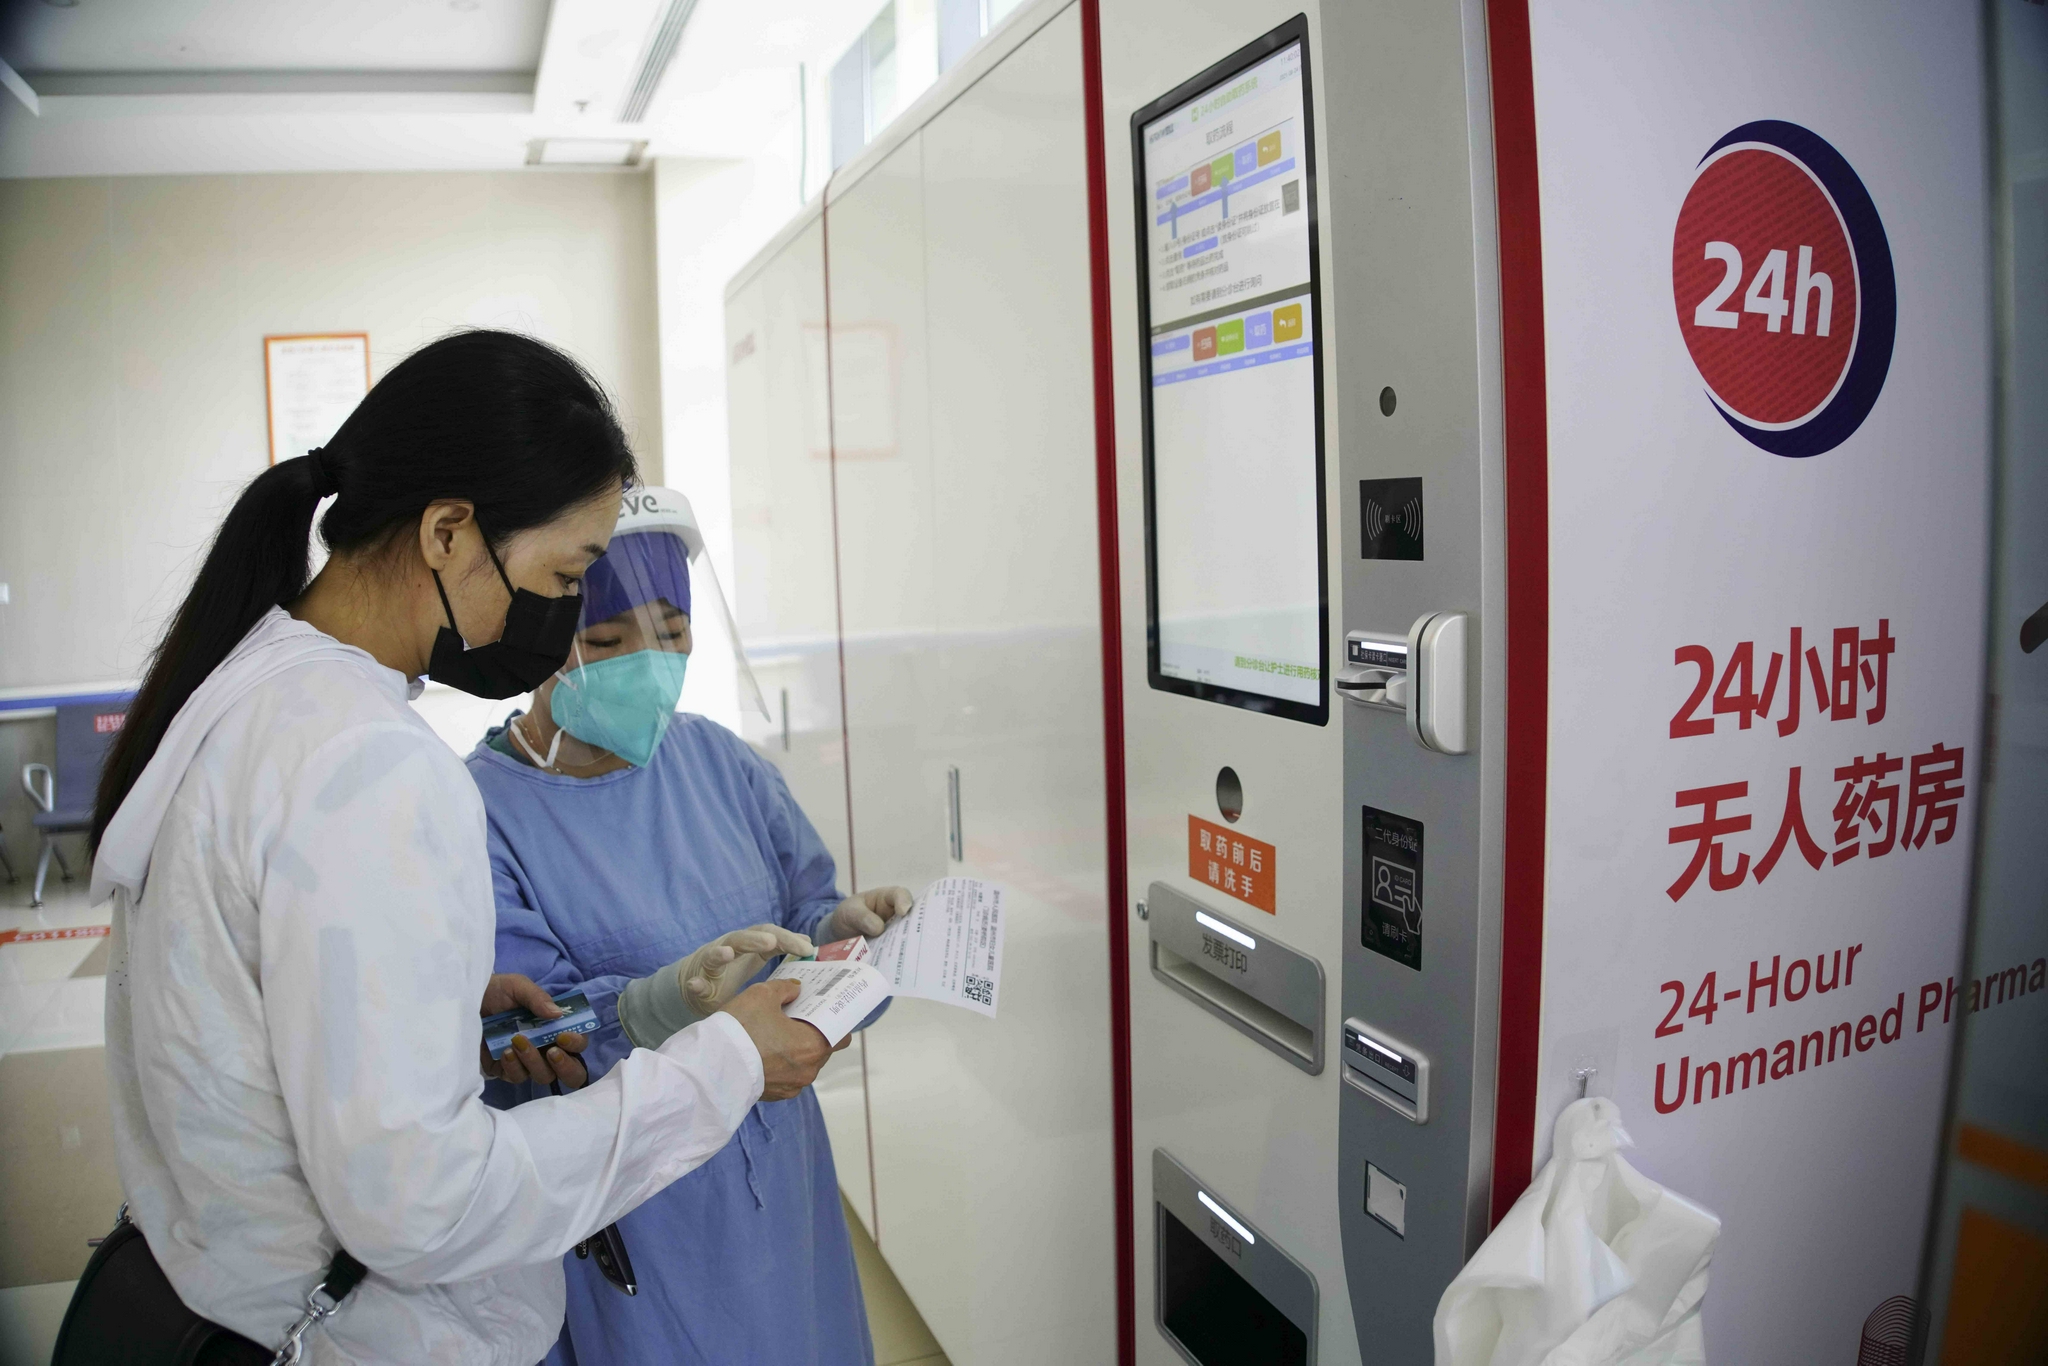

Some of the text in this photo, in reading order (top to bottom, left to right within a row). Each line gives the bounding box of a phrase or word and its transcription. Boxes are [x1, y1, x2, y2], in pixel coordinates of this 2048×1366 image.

[1694, 240, 1834, 337] 24h
[1384, 513, 1402, 524] 刷卡区
[1669, 618, 1896, 739] 24小时
[1375, 827, 1418, 853] 二代身份证
[1666, 742, 1965, 903] 无人药房
[1200, 828, 1262, 873] 取药前后
[1207, 861, 1254, 898] 请洗手
[1201, 932, 1248, 975] 发票打印
[1381, 921, 1408, 944] 请刷卡
[830, 978, 869, 1016] 药品用法说明
[1655, 942, 1863, 1040] 24-Hour
[1653, 992, 1905, 1116] Unmanned
[1209, 1216, 1242, 1260] 取药口
